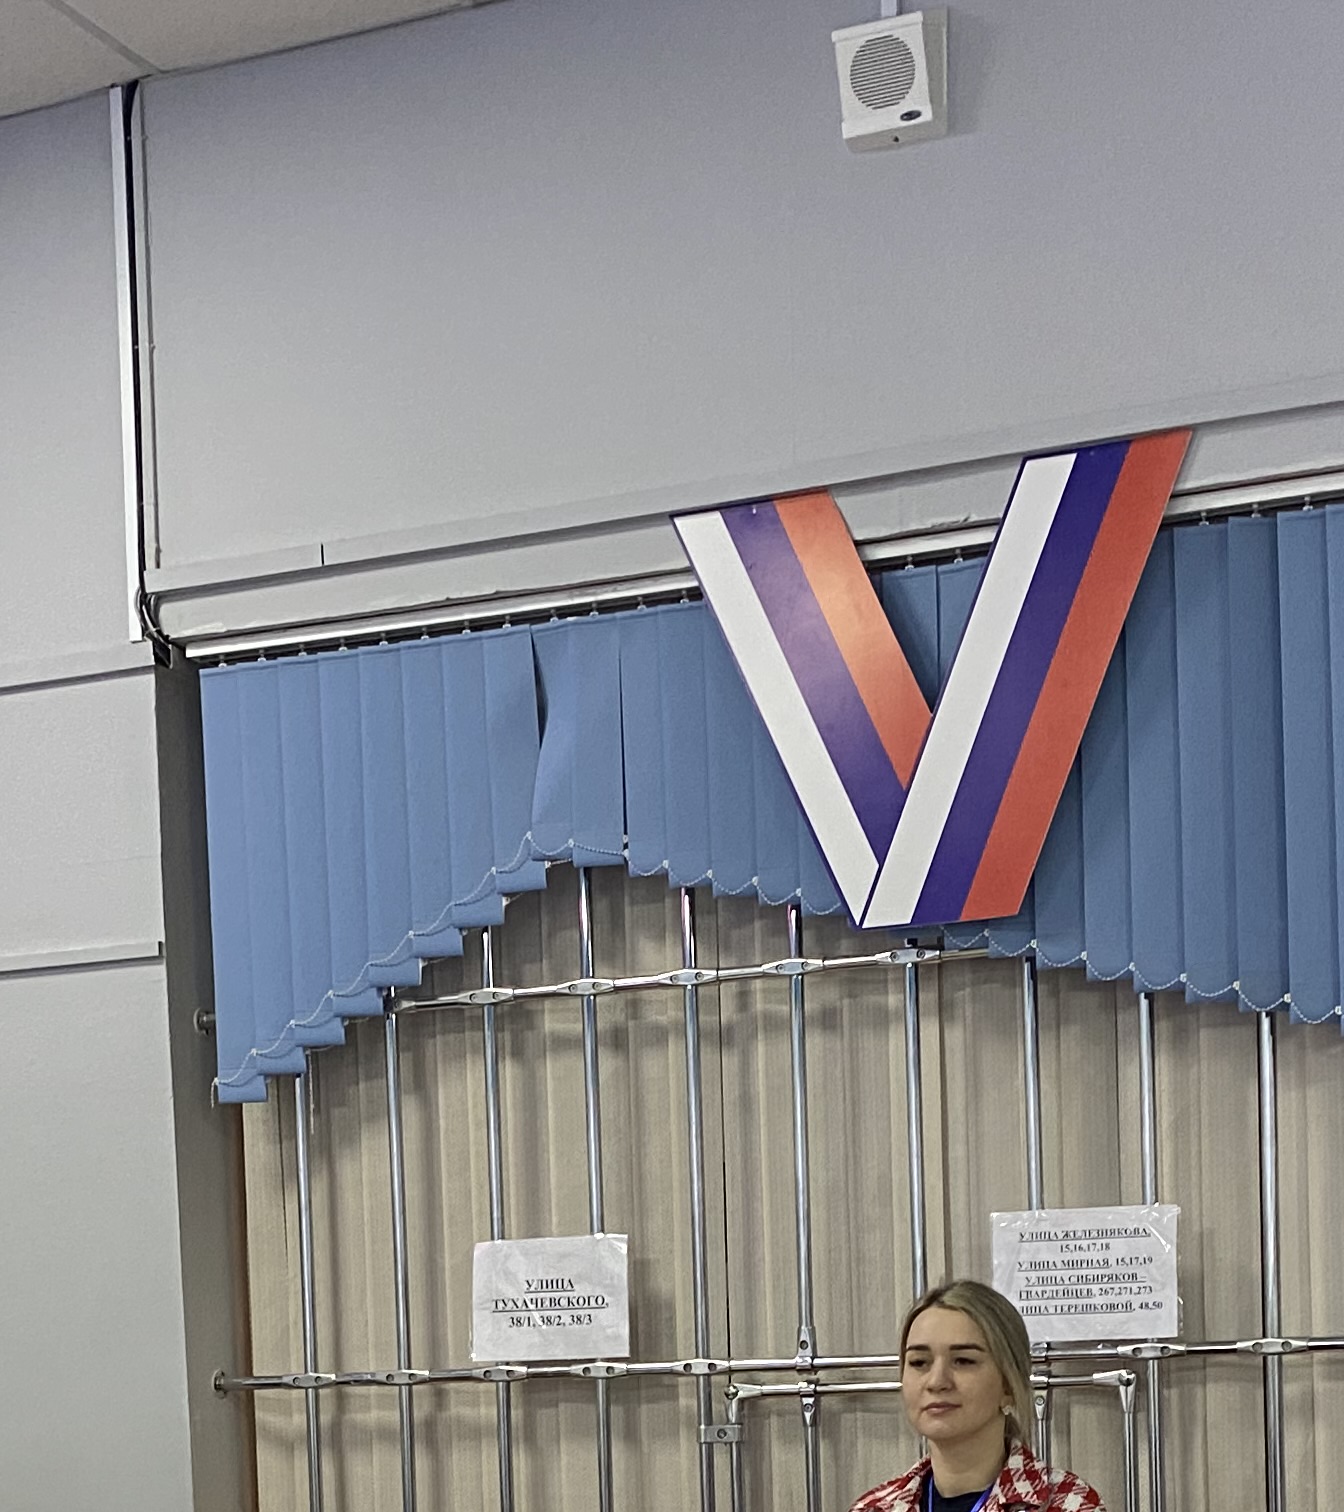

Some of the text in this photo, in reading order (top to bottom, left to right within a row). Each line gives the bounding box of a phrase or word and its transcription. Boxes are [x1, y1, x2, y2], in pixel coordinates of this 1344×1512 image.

[1019, 1231, 1059, 1241] УЛИЦА
[1018, 1260, 1058, 1271] УЛИЦА
[525, 1278, 574, 1291] УЛИЦА
[1025, 1275, 1065, 1285] УЛИЦА
[1068, 1273, 1138, 1283] СИБИРЯКОВ
[569, 1314, 592, 1325] 38/3
